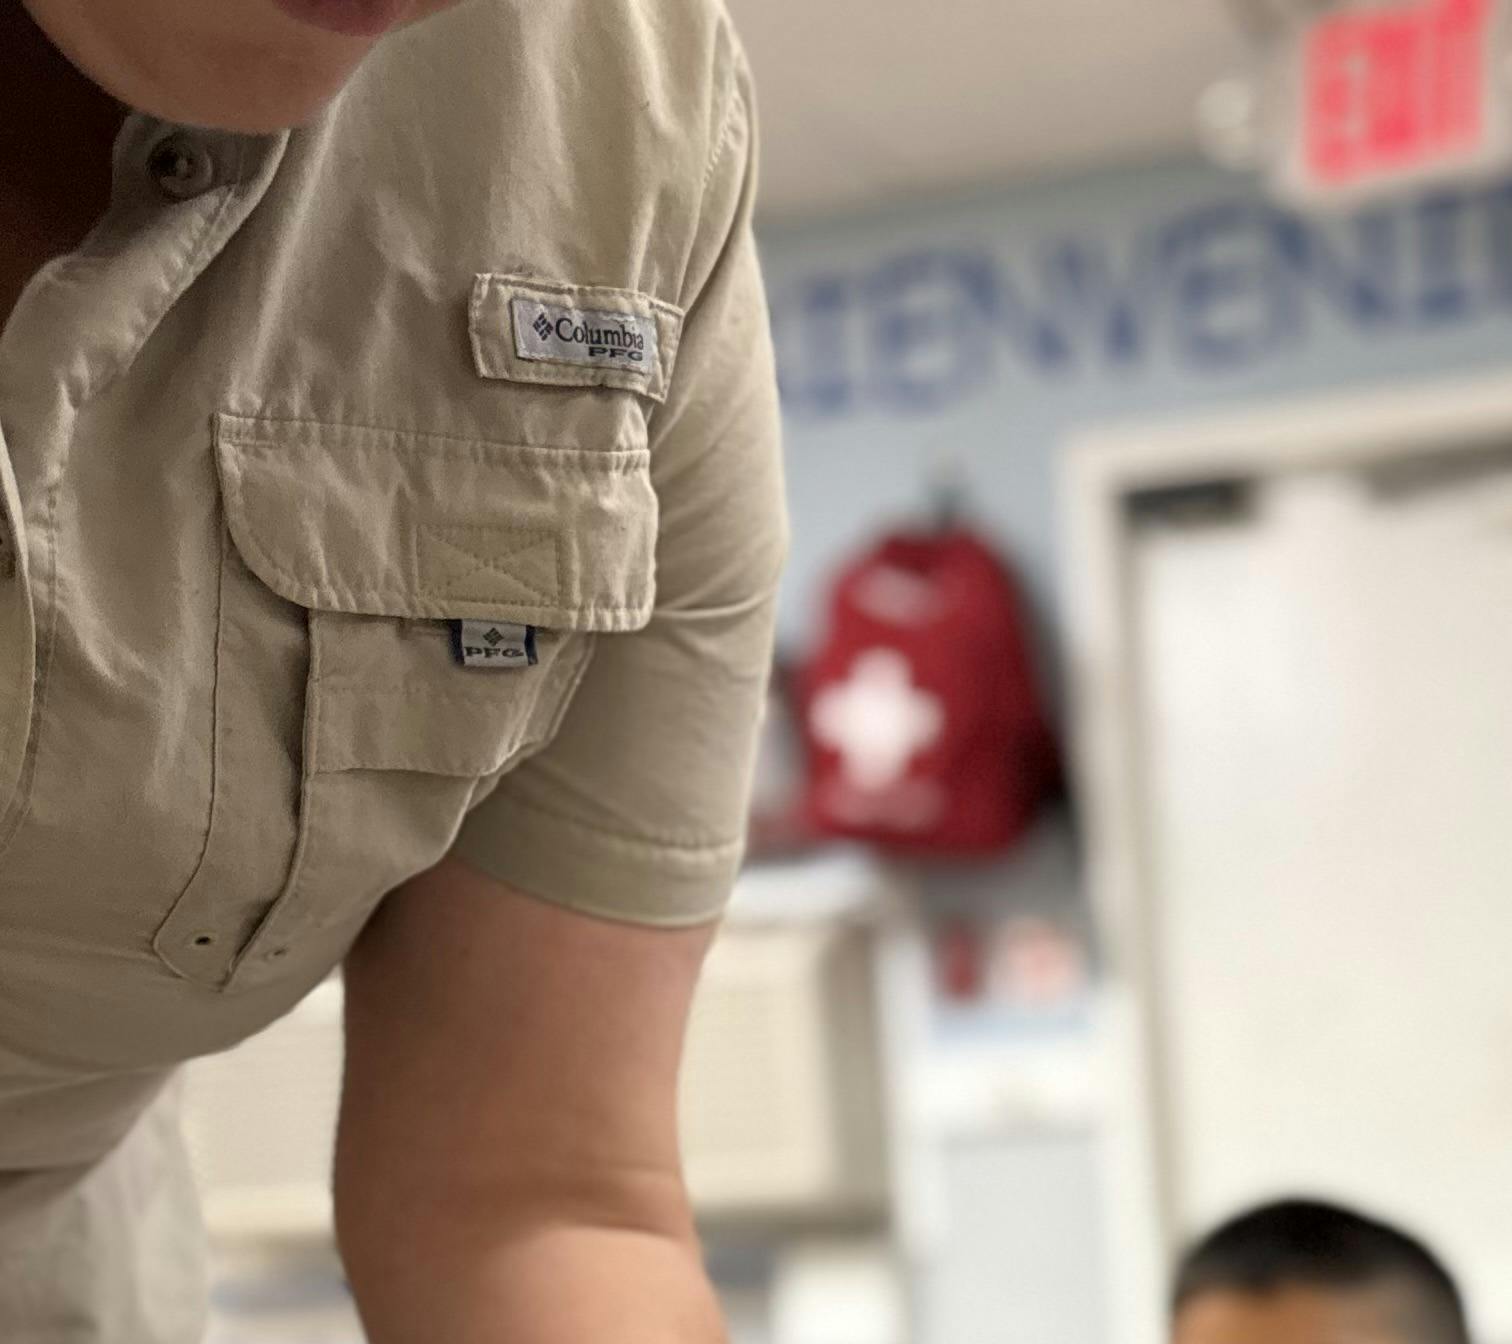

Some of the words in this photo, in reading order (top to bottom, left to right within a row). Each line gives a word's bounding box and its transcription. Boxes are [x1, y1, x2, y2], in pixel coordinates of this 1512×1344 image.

[1302, 0, 1490, 188] EXIT
[555, 317, 644, 350] Columbia
[589, 346, 643, 361] PFG
[464, 646, 524, 658] PFG
